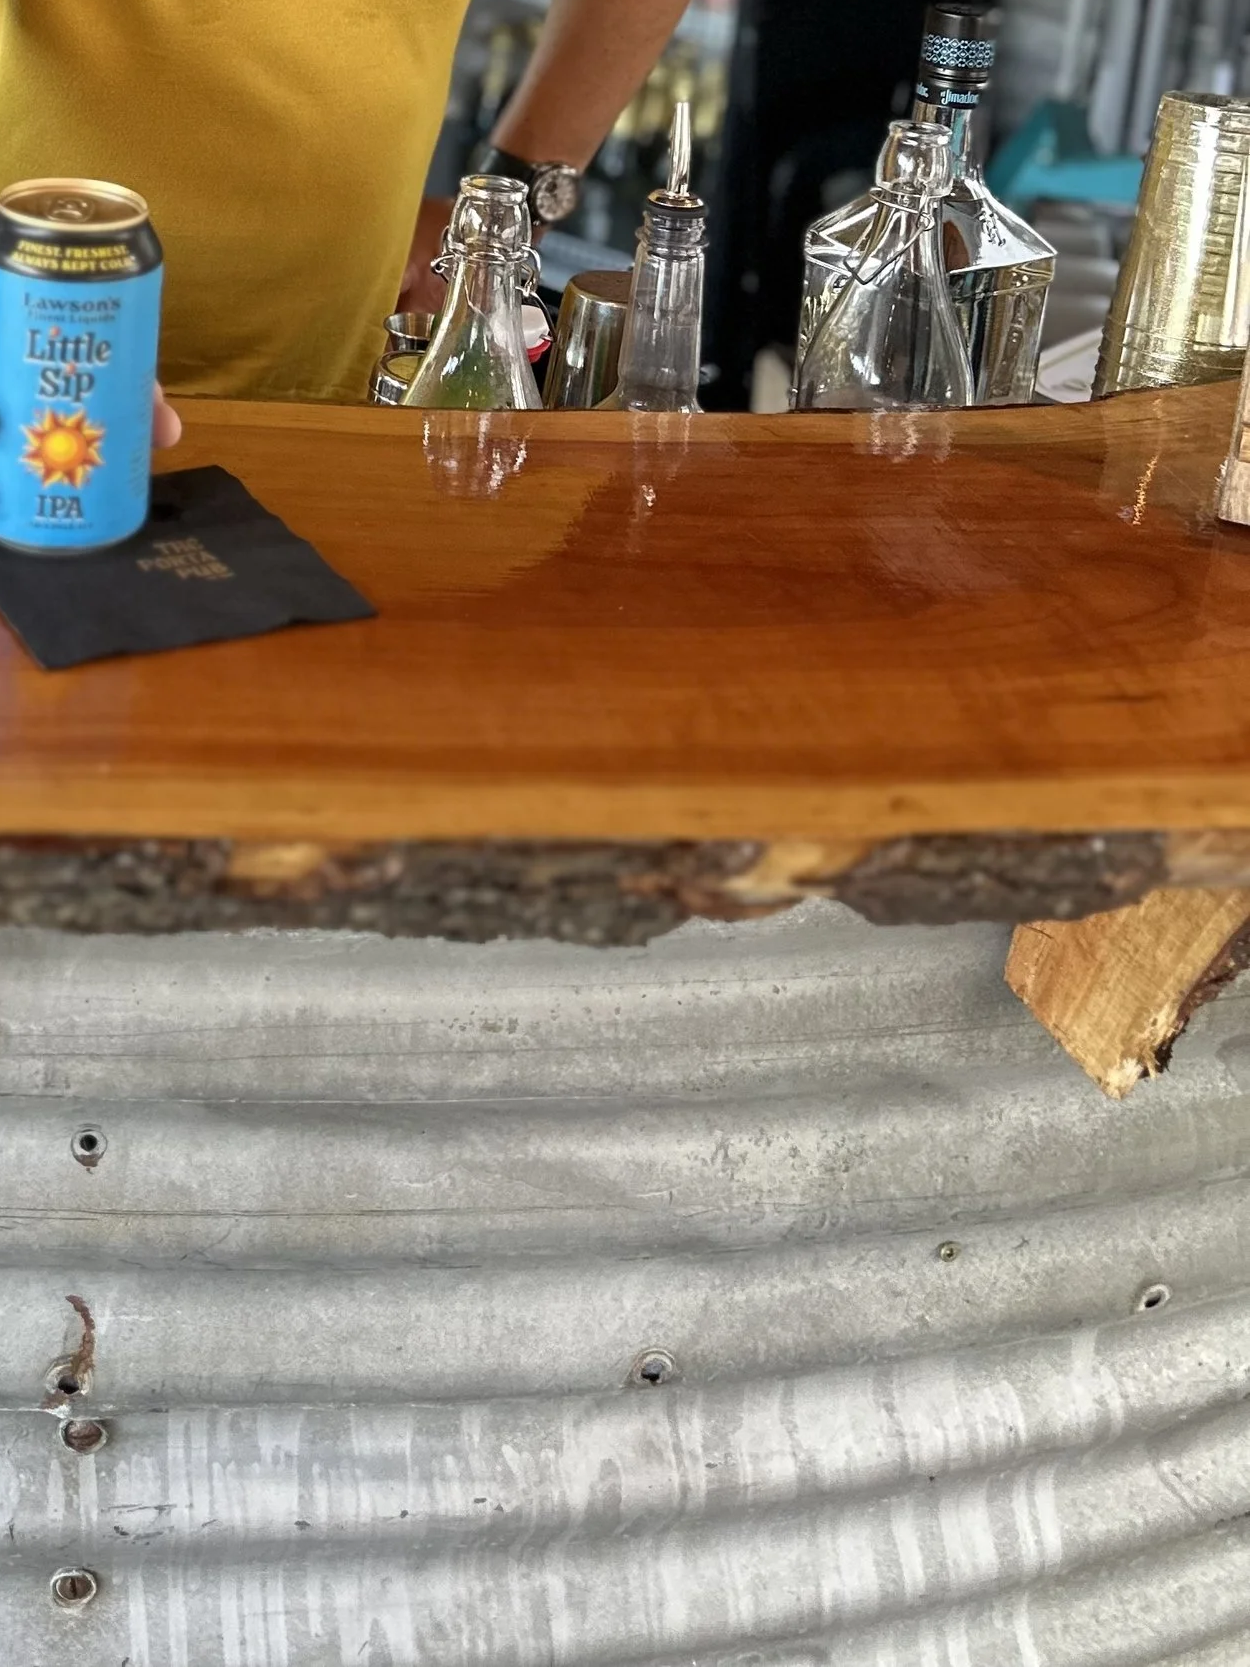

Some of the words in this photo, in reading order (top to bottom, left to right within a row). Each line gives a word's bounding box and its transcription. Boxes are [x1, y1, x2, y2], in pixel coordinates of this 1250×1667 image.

[10, 250, 59, 271] ALWAYS
[61, 259, 97, 273] KEPT
[25, 326, 112, 365] Little
[38, 362, 96, 403] Sip
[35, 494, 85, 520] IPA
